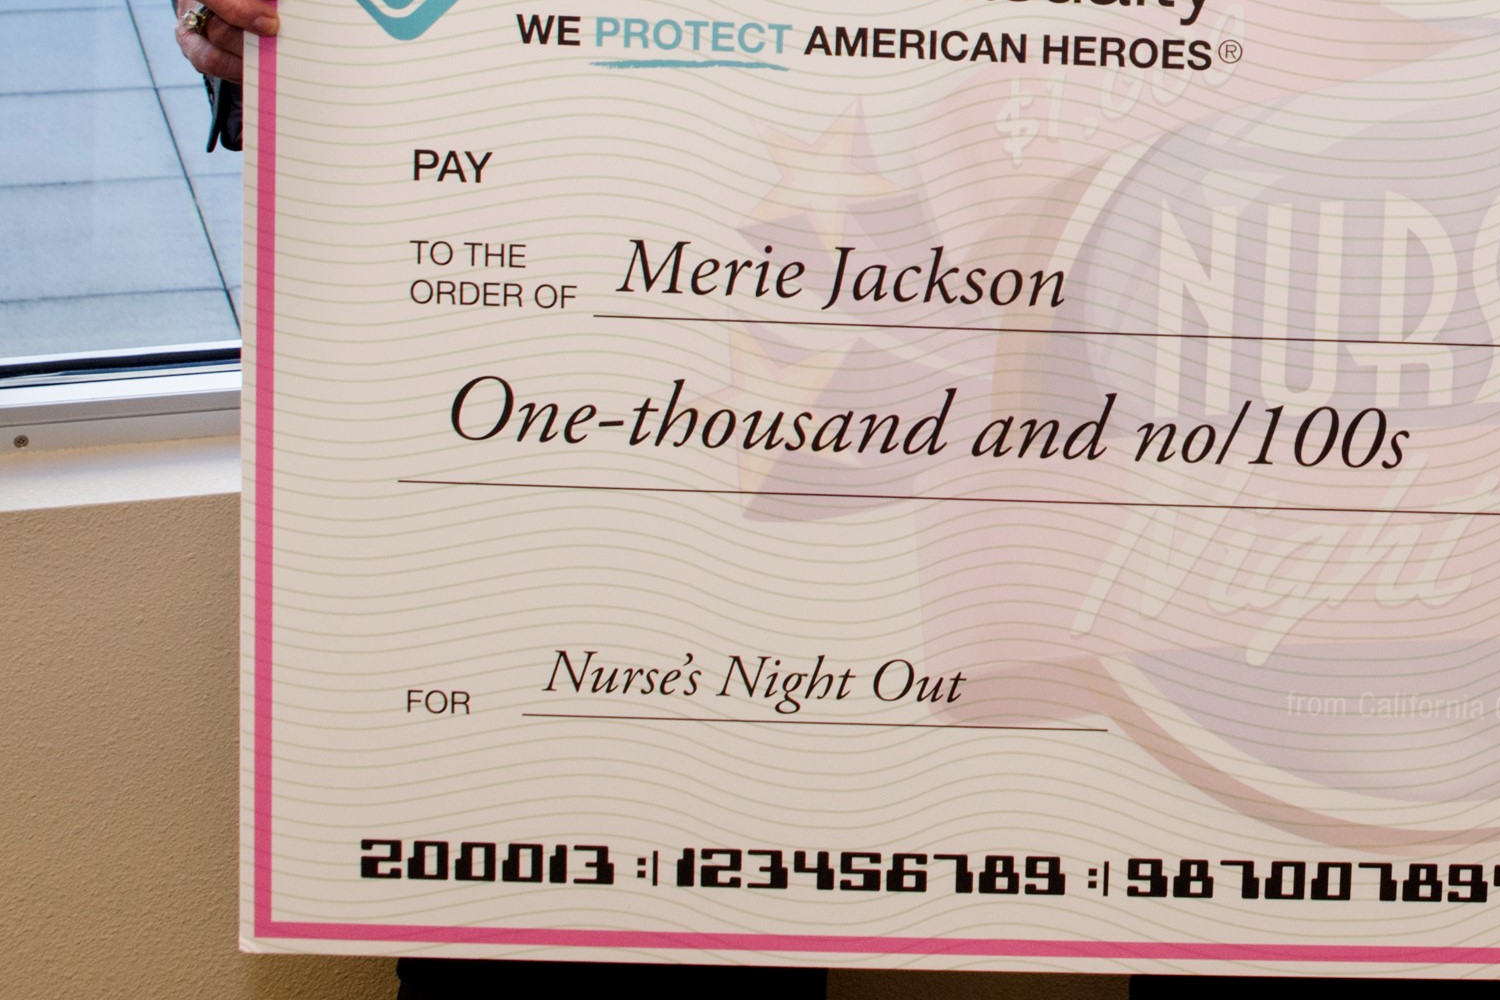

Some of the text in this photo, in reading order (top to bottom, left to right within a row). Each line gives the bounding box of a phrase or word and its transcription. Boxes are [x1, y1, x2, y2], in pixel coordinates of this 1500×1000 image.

[515, 13, 582, 47] WE
[594, 16, 793, 55] PROTECT
[803, 25, 1028, 64] AMERICAN
[413, 148, 493, 184] PAY
[409, 239, 527, 269] TO THE
[615, 239, 1066, 311] Merie Jackson
[409, 278, 578, 310] ORDER OF
[450, 375, 1411, 471] One-thousand and no/100s
[541, 649, 969, 716] Nurse's Night Out
[406, 689, 471, 716] FOR
[1285, 690, 1349, 719] from
[1357, 691, 1487, 721] California
